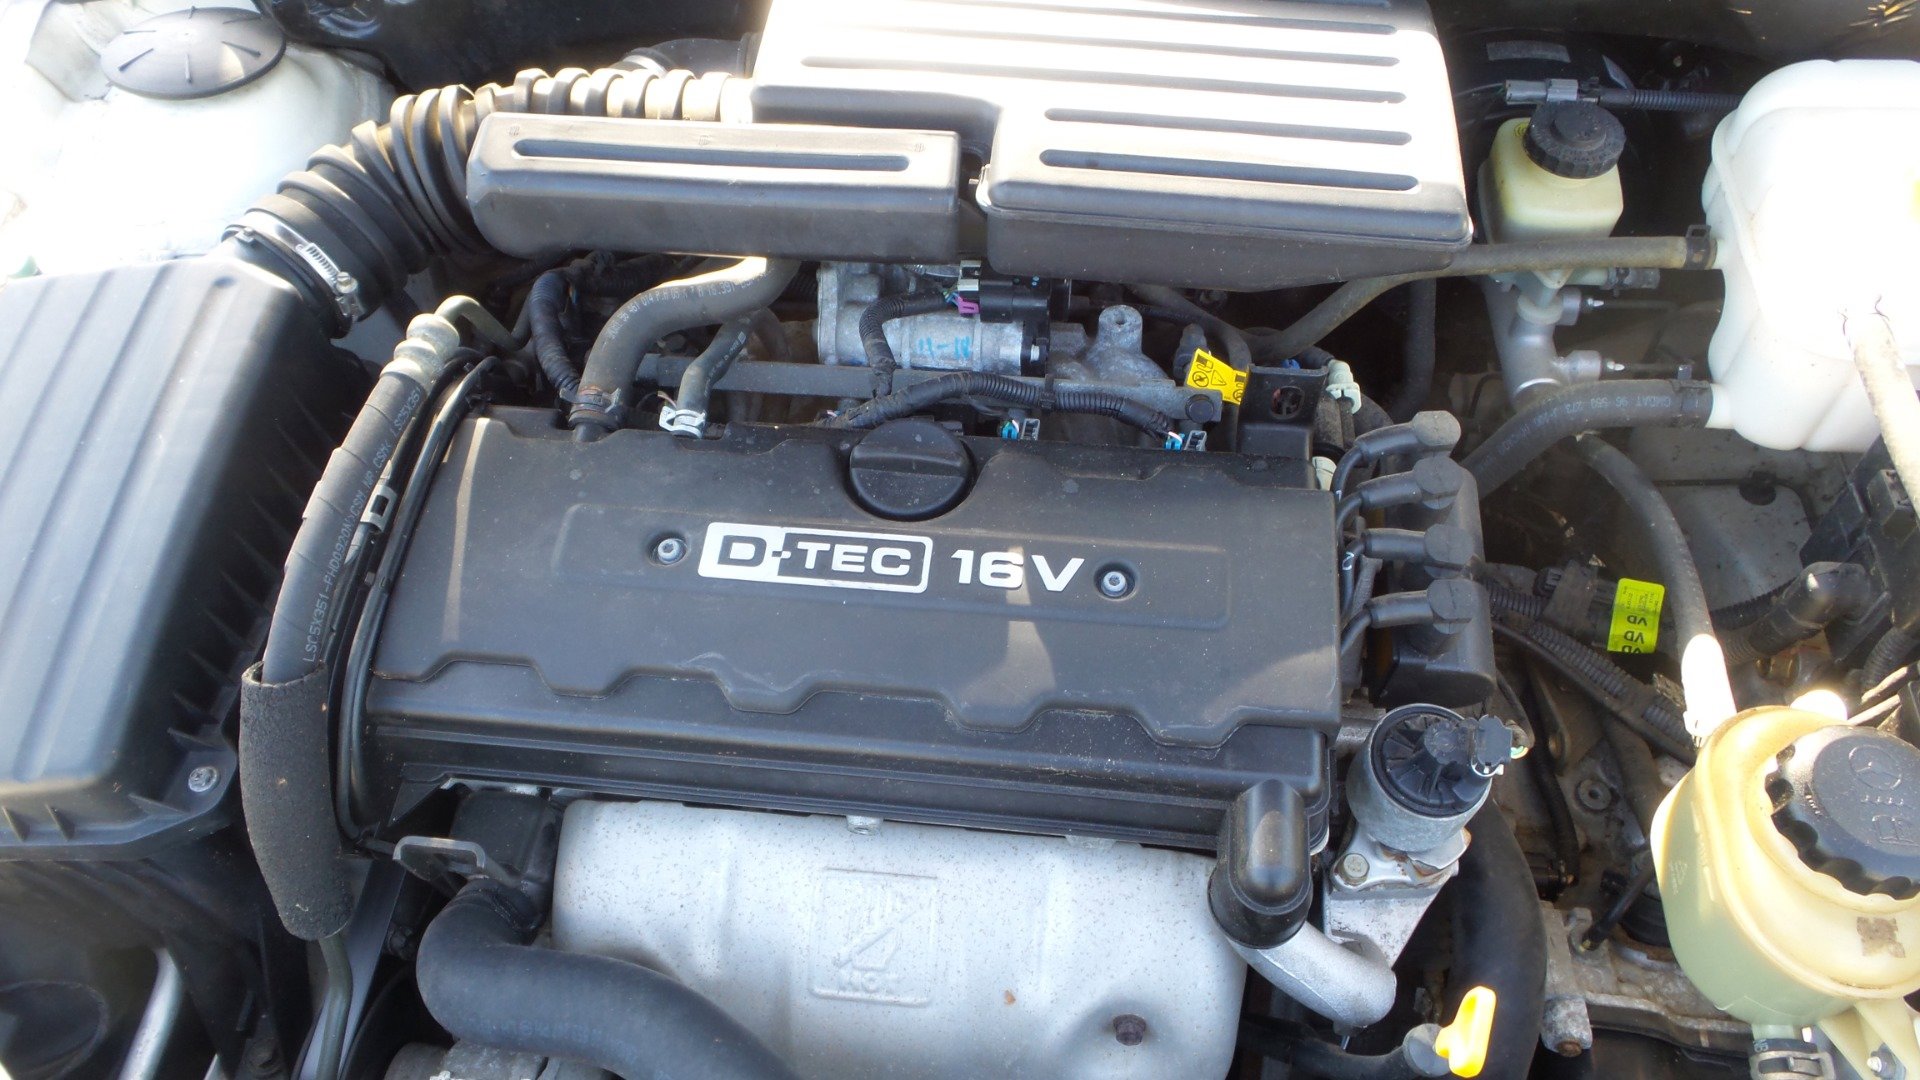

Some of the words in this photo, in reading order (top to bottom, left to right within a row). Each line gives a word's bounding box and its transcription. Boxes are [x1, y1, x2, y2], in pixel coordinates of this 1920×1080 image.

[717, 534, 912, 577] D-TEC
[1626, 614, 1648, 627] VD
[1623, 630, 1645, 645] VD
